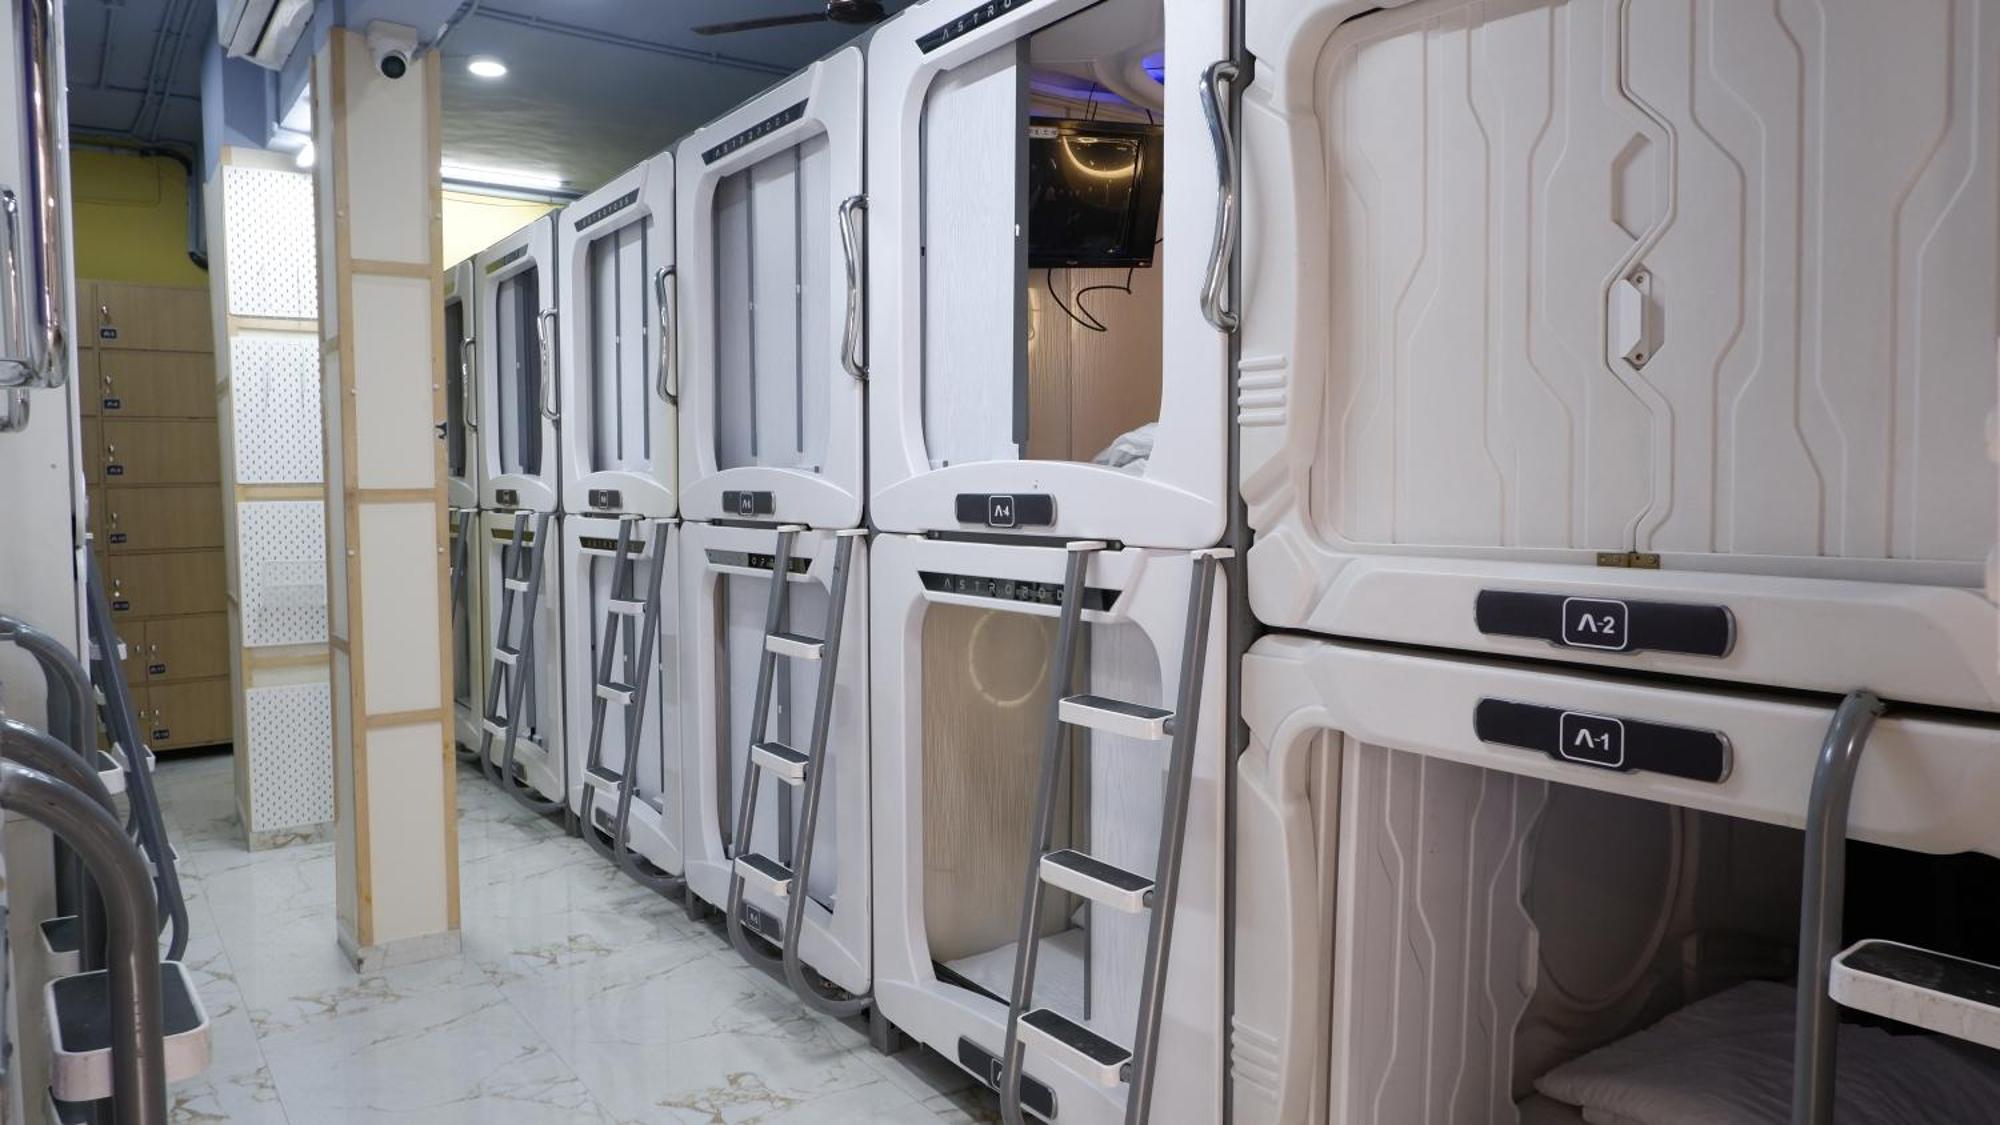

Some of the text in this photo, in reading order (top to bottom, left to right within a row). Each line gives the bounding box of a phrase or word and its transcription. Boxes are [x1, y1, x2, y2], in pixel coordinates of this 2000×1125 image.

[944, 577, 1064, 600] ASTROPOD
[1577, 613, 1616, 634] A-2
[1574, 728, 1610, 750] A-1
